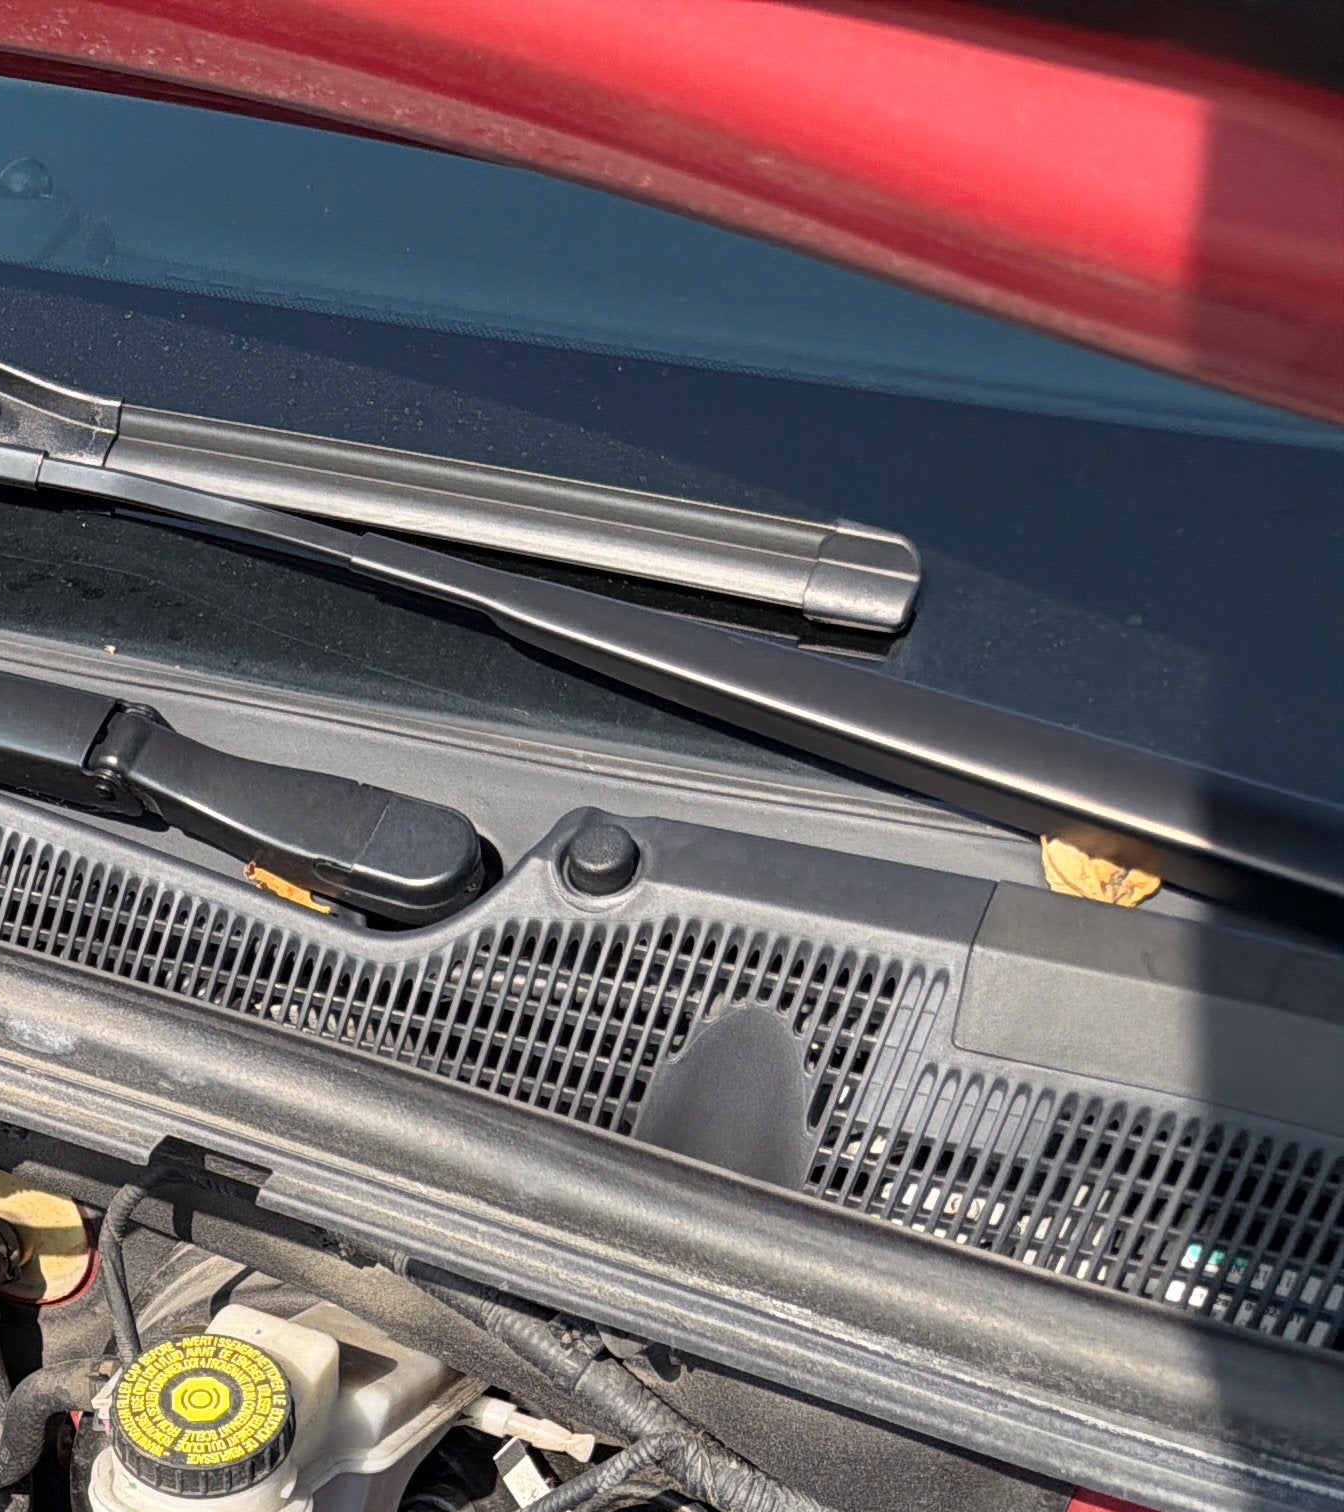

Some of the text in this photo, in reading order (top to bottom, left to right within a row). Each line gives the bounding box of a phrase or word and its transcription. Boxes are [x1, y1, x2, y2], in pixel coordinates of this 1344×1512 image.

[124, 1364, 141, 1381] CAP
[131, 1396, 144, 1412] USE
[273, 1395, 286, 1405] LE
[242, 1438, 259, 1452] DE
